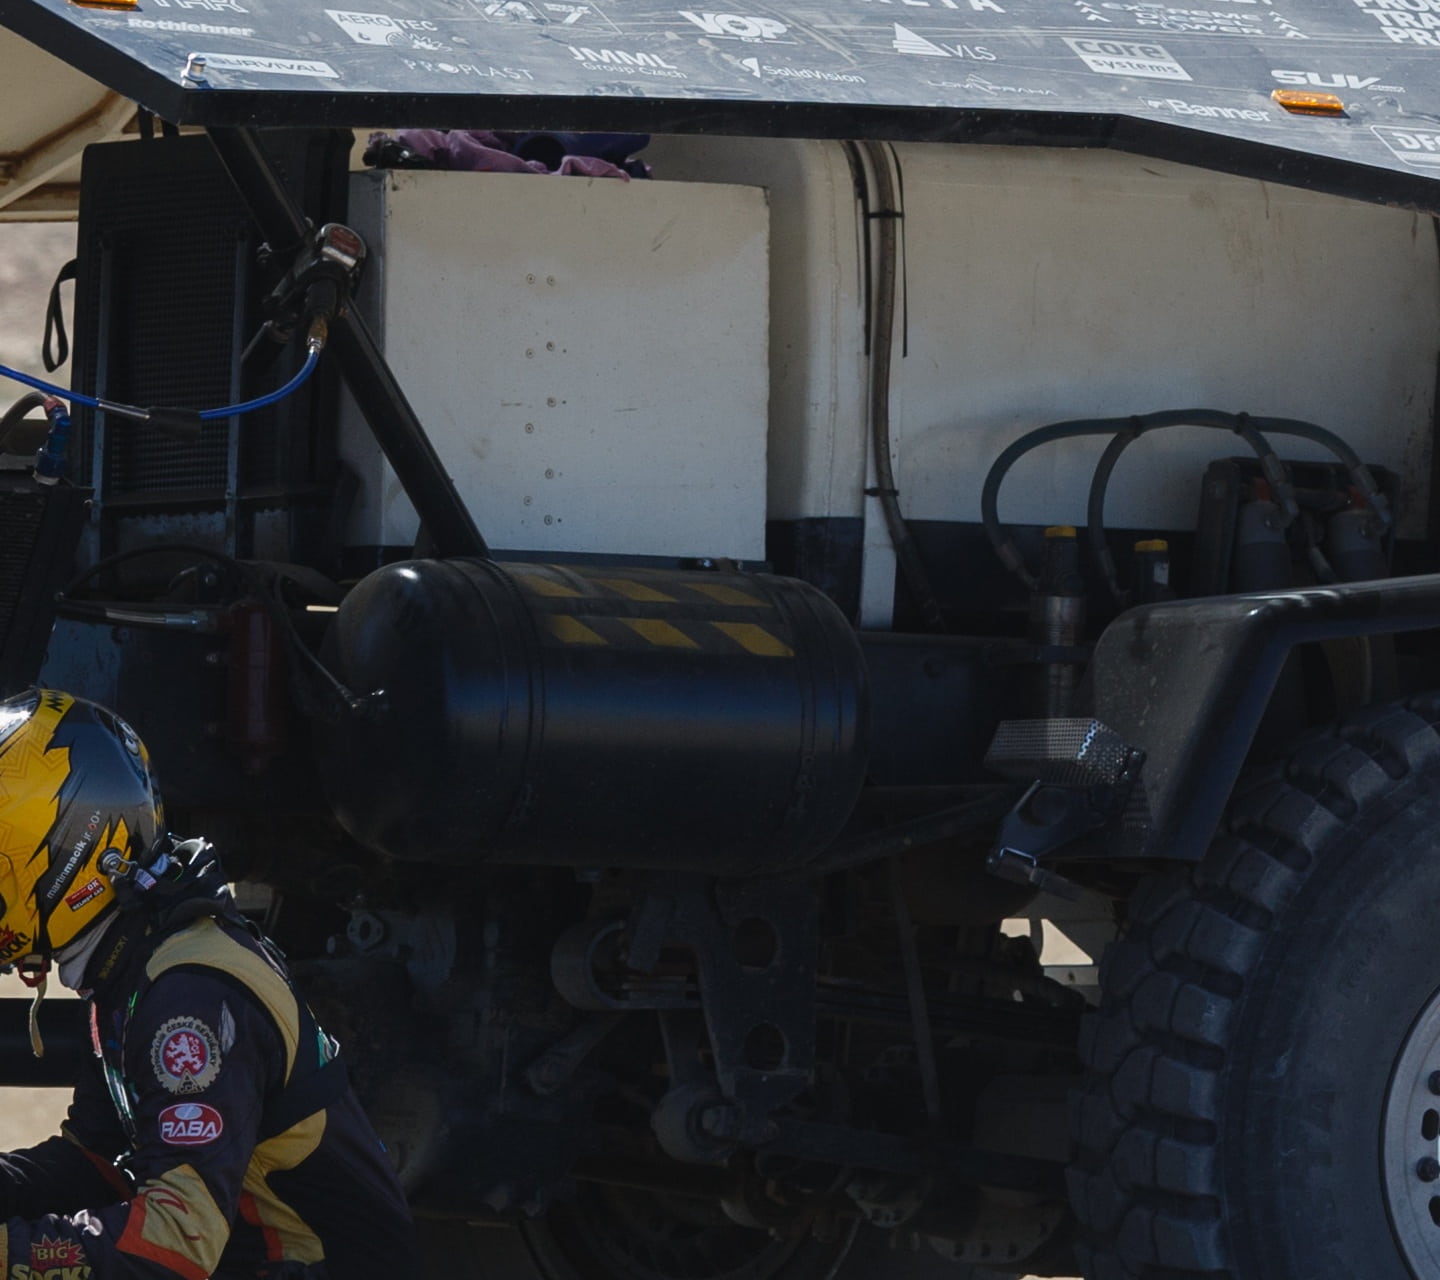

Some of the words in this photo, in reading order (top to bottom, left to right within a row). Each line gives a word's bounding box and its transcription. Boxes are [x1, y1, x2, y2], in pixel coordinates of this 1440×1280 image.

[126, 17, 256, 38] Rothlehner
[677, 9, 789, 39] VOP
[1076, 38, 1165, 60] core
[762, 64, 867, 84] SolidVision
[1090, 57, 1181, 77] systems
[1163, 96, 1272, 122] Banner
[162, 1119, 219, 1138] RABA
[35, 1245, 70, 1262] BIG
